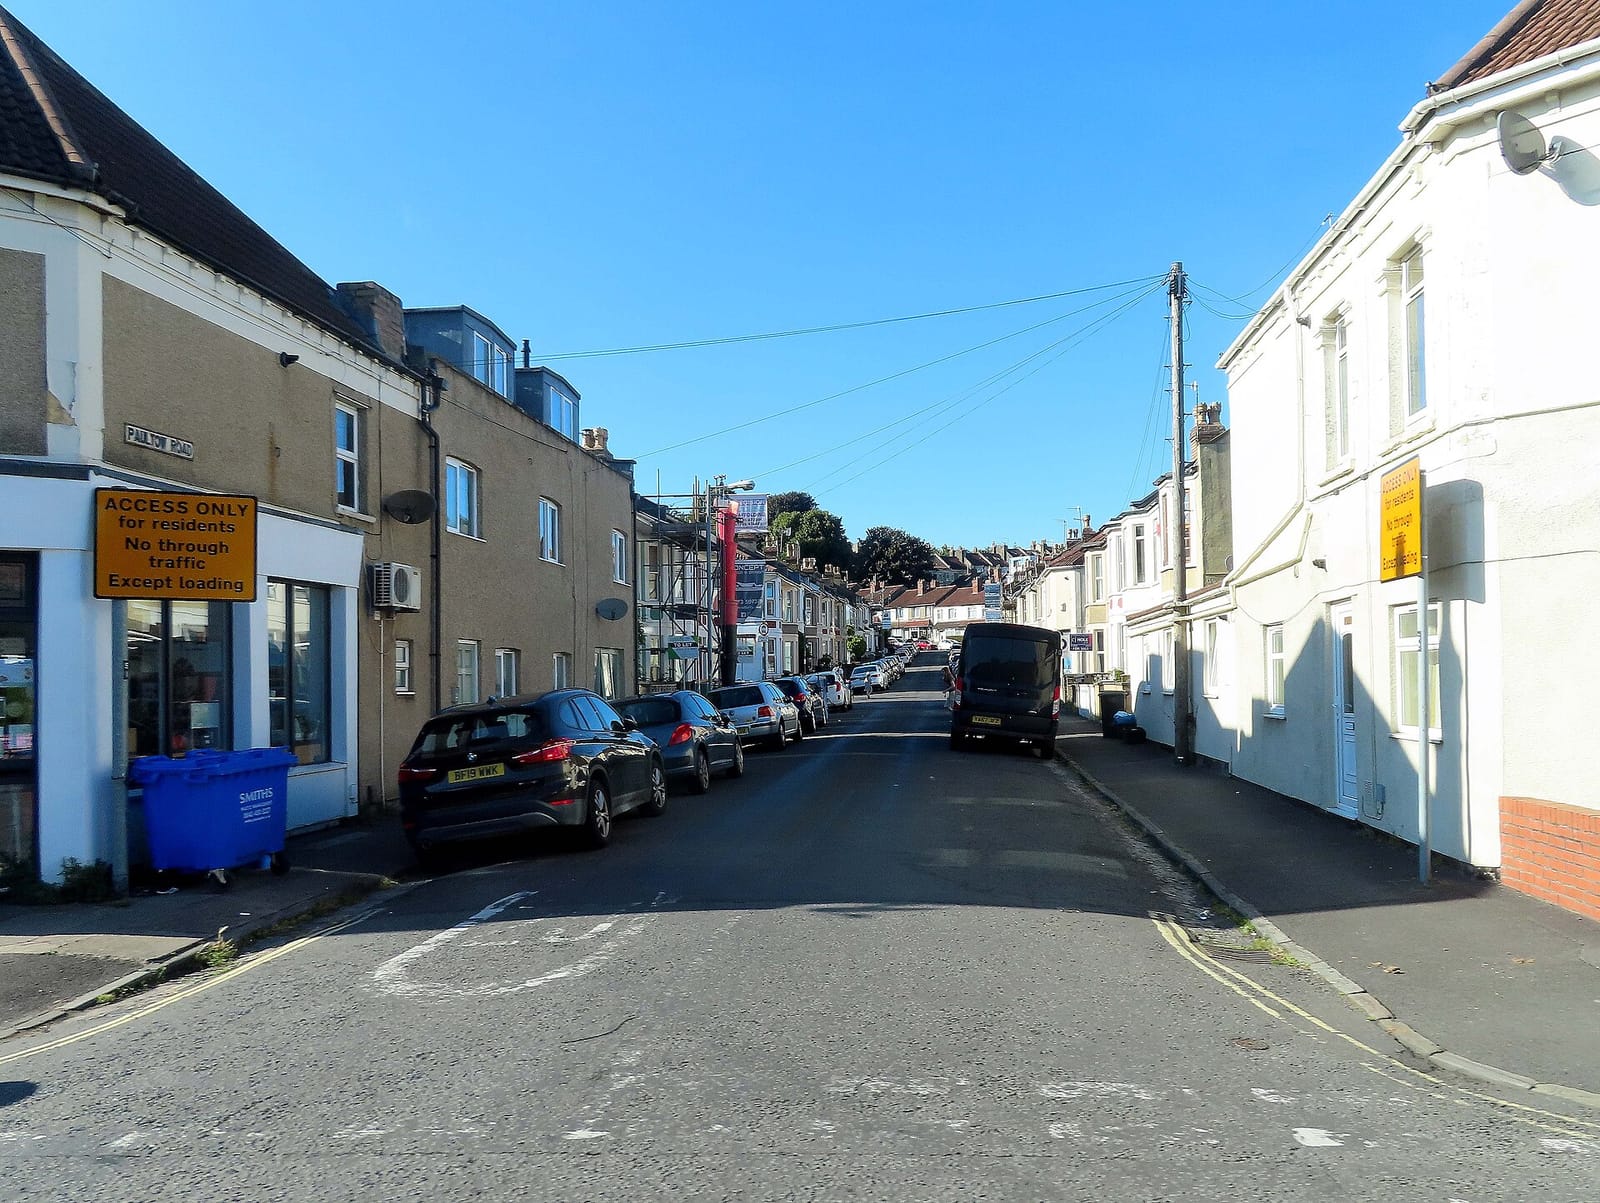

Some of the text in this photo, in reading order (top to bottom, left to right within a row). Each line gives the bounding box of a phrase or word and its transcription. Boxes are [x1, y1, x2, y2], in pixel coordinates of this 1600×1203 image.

[105, 497, 248, 517] ACCESS ONLY
[118, 515, 236, 533] for residents
[125, 537, 229, 556] No through
[149, 556, 206, 570] traffic
[109, 573, 244, 592] Except loading
[454, 765, 498, 781] BF19 WWK
[239, 787, 273, 804] SMITHS
